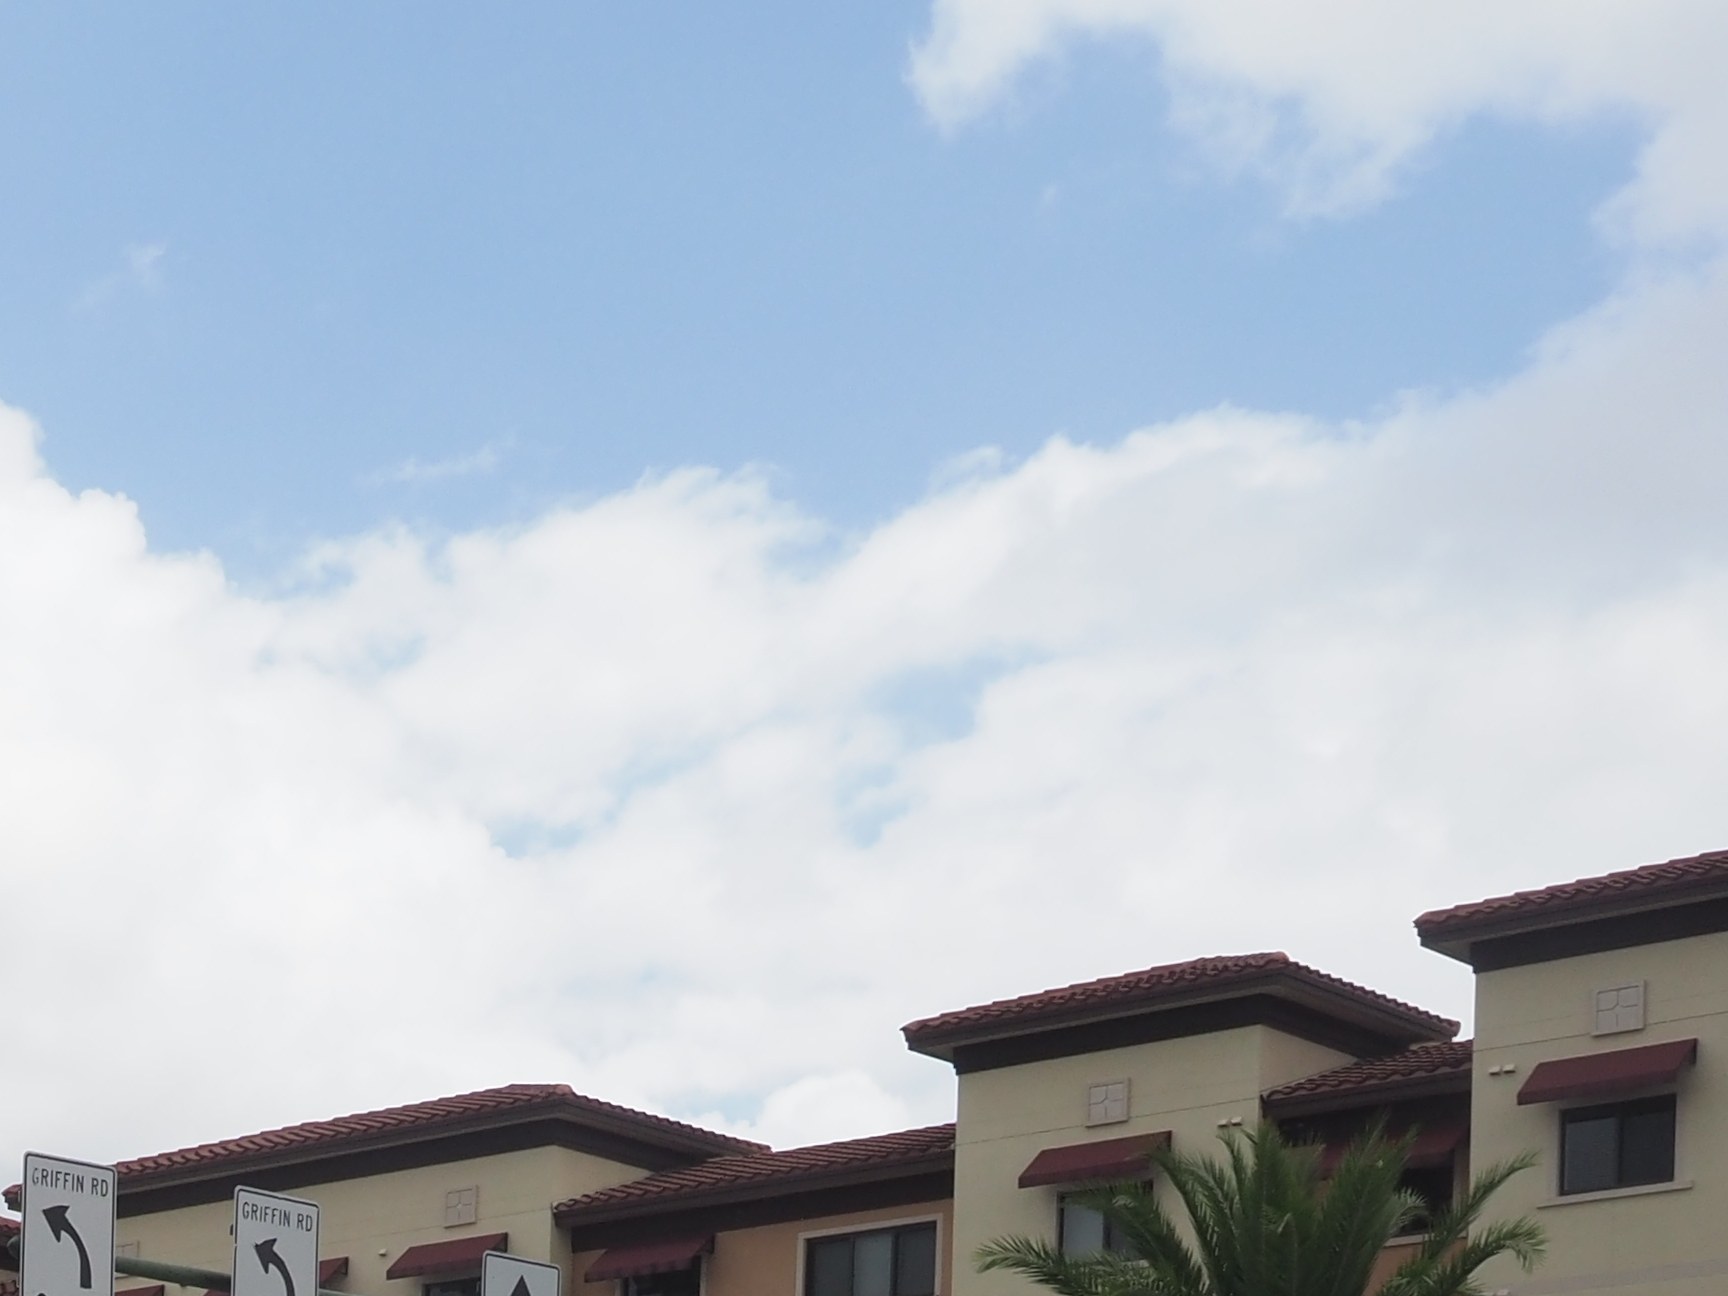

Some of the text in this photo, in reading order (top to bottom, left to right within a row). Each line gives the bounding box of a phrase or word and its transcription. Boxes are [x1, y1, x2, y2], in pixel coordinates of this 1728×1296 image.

[32, 1167, 109, 1198] GRIFFIN RD
[242, 1201, 313, 1232] GRIFFIN RD
